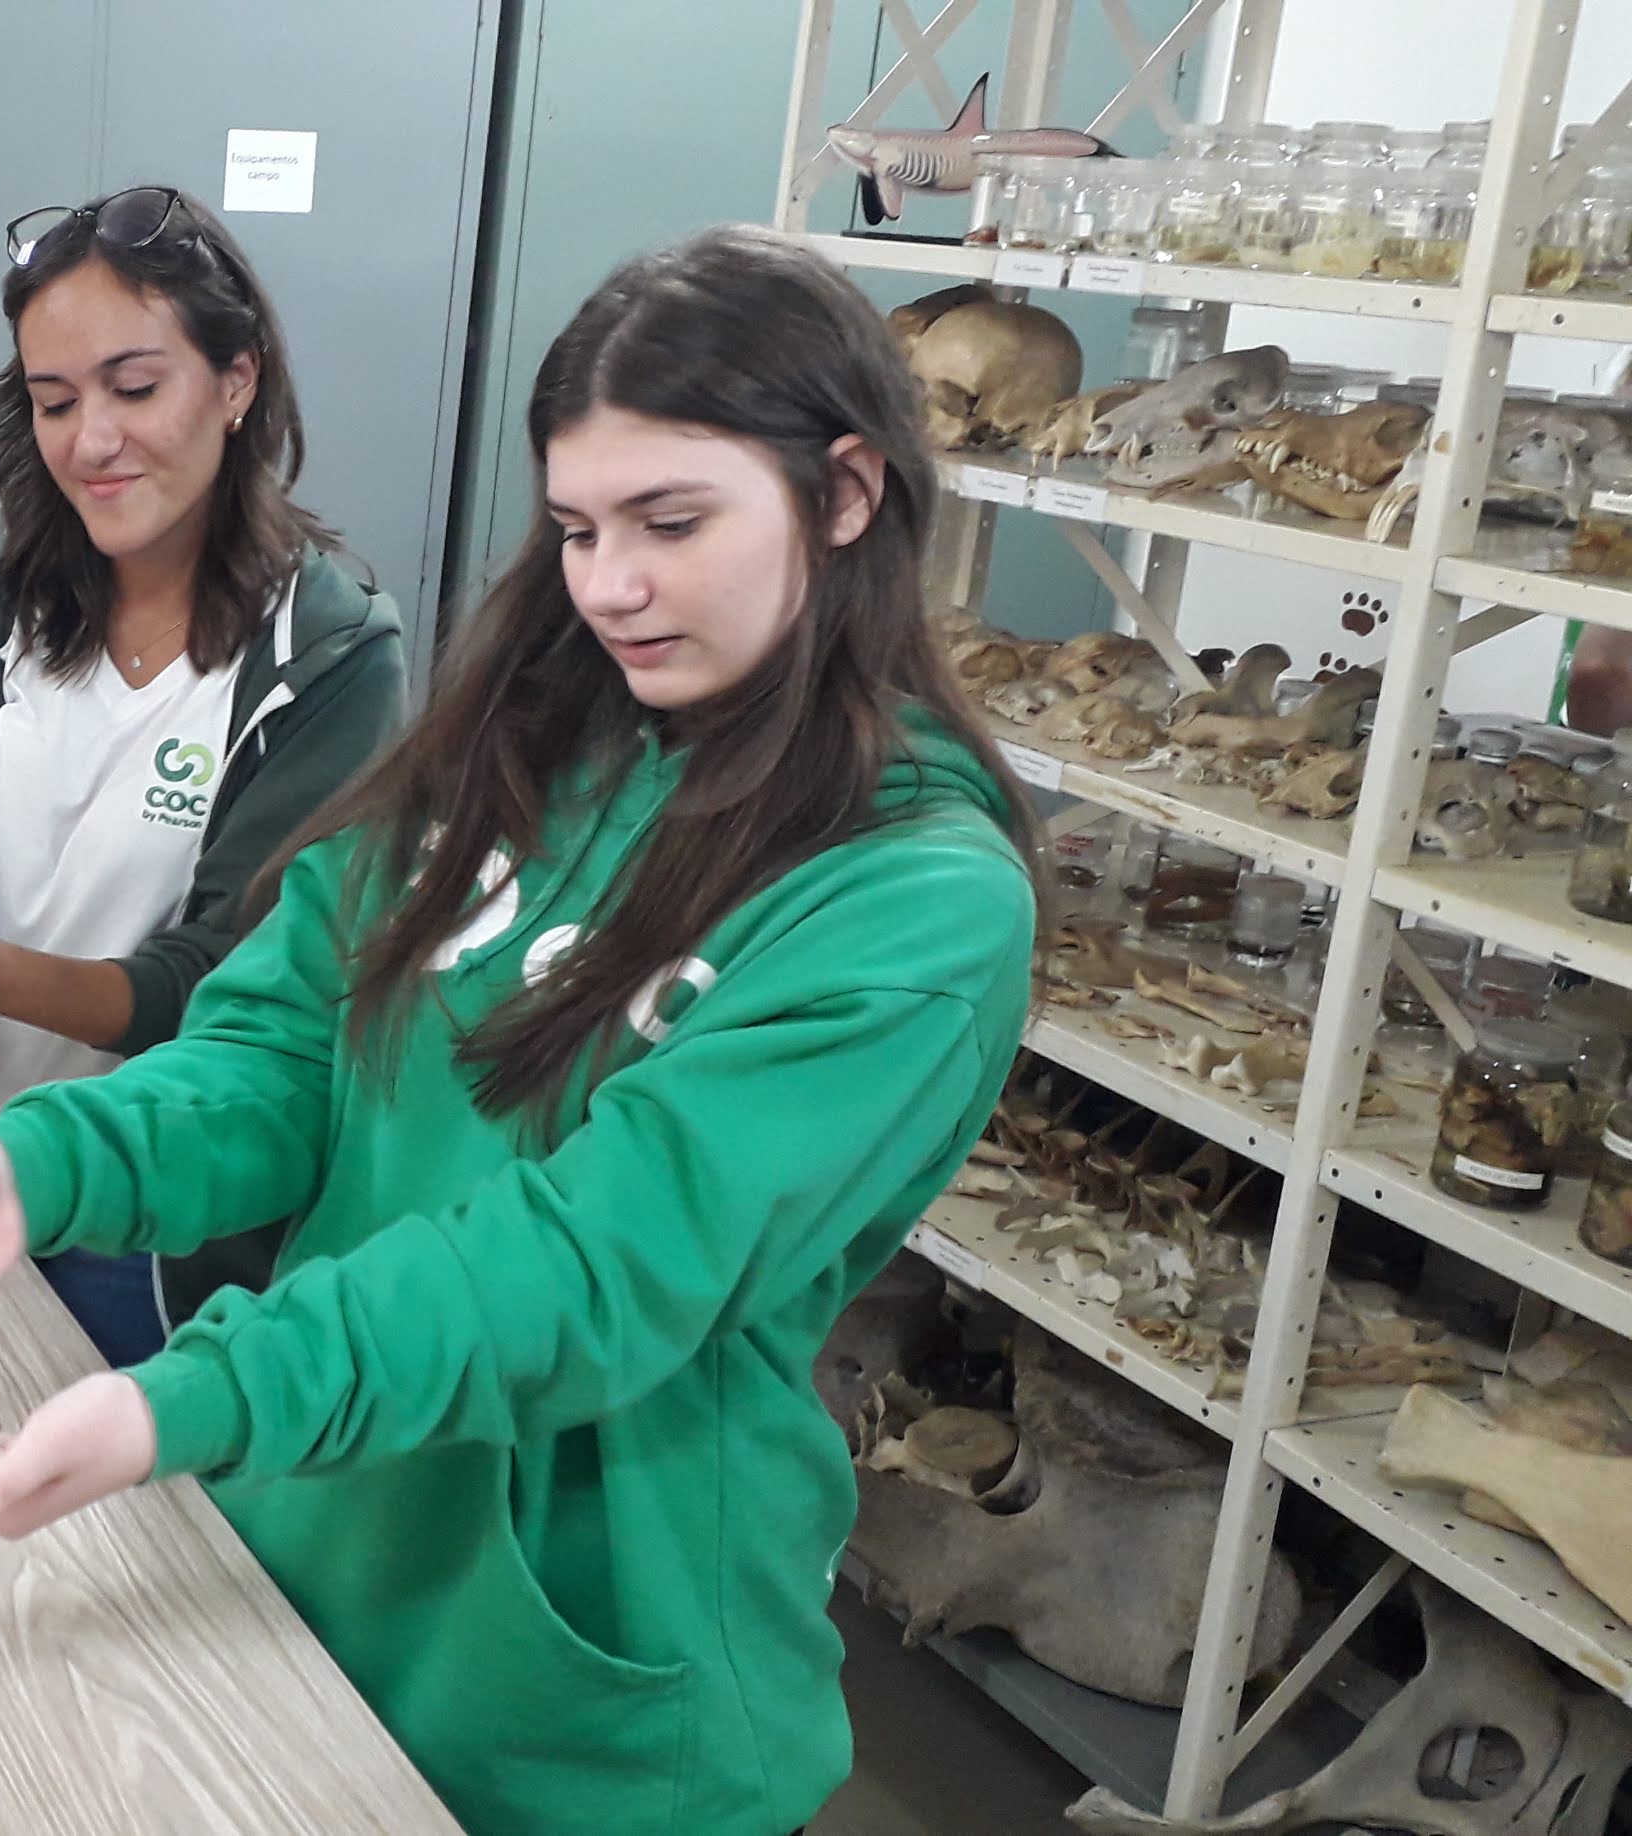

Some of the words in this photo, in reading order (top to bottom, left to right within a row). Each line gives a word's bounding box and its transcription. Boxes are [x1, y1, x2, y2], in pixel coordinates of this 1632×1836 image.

[231, 151, 299, 165] Equipamentos
[247, 171, 280, 181] campo
[144, 785, 209, 817] COC
[141, 809, 157, 823] by
[157, 812, 203, 829] Pearson
